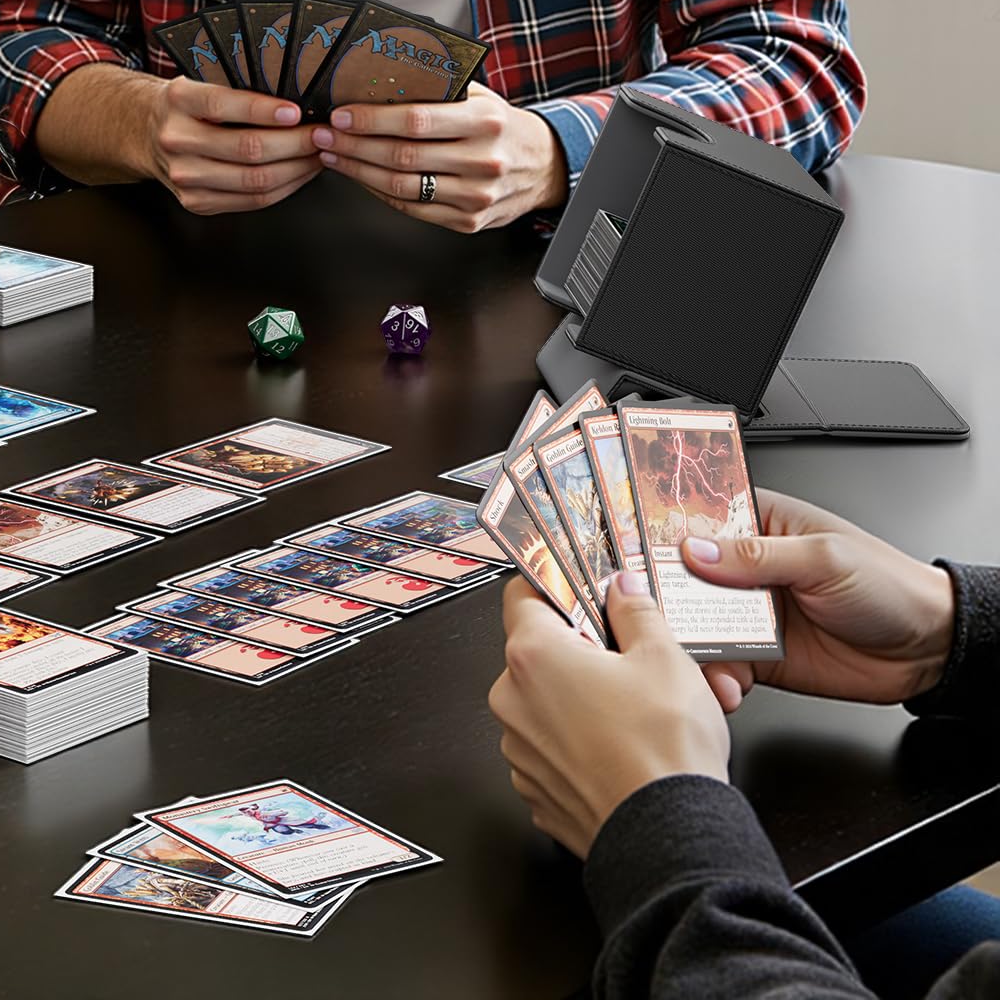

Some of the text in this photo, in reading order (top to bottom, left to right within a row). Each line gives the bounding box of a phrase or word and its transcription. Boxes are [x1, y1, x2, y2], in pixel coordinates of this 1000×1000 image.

[629, 415, 672, 426] Lightning Bolt
[546, 447, 566, 462] Goblin
[518, 458, 536, 477] Smash
[490, 500, 505, 520] Shock
